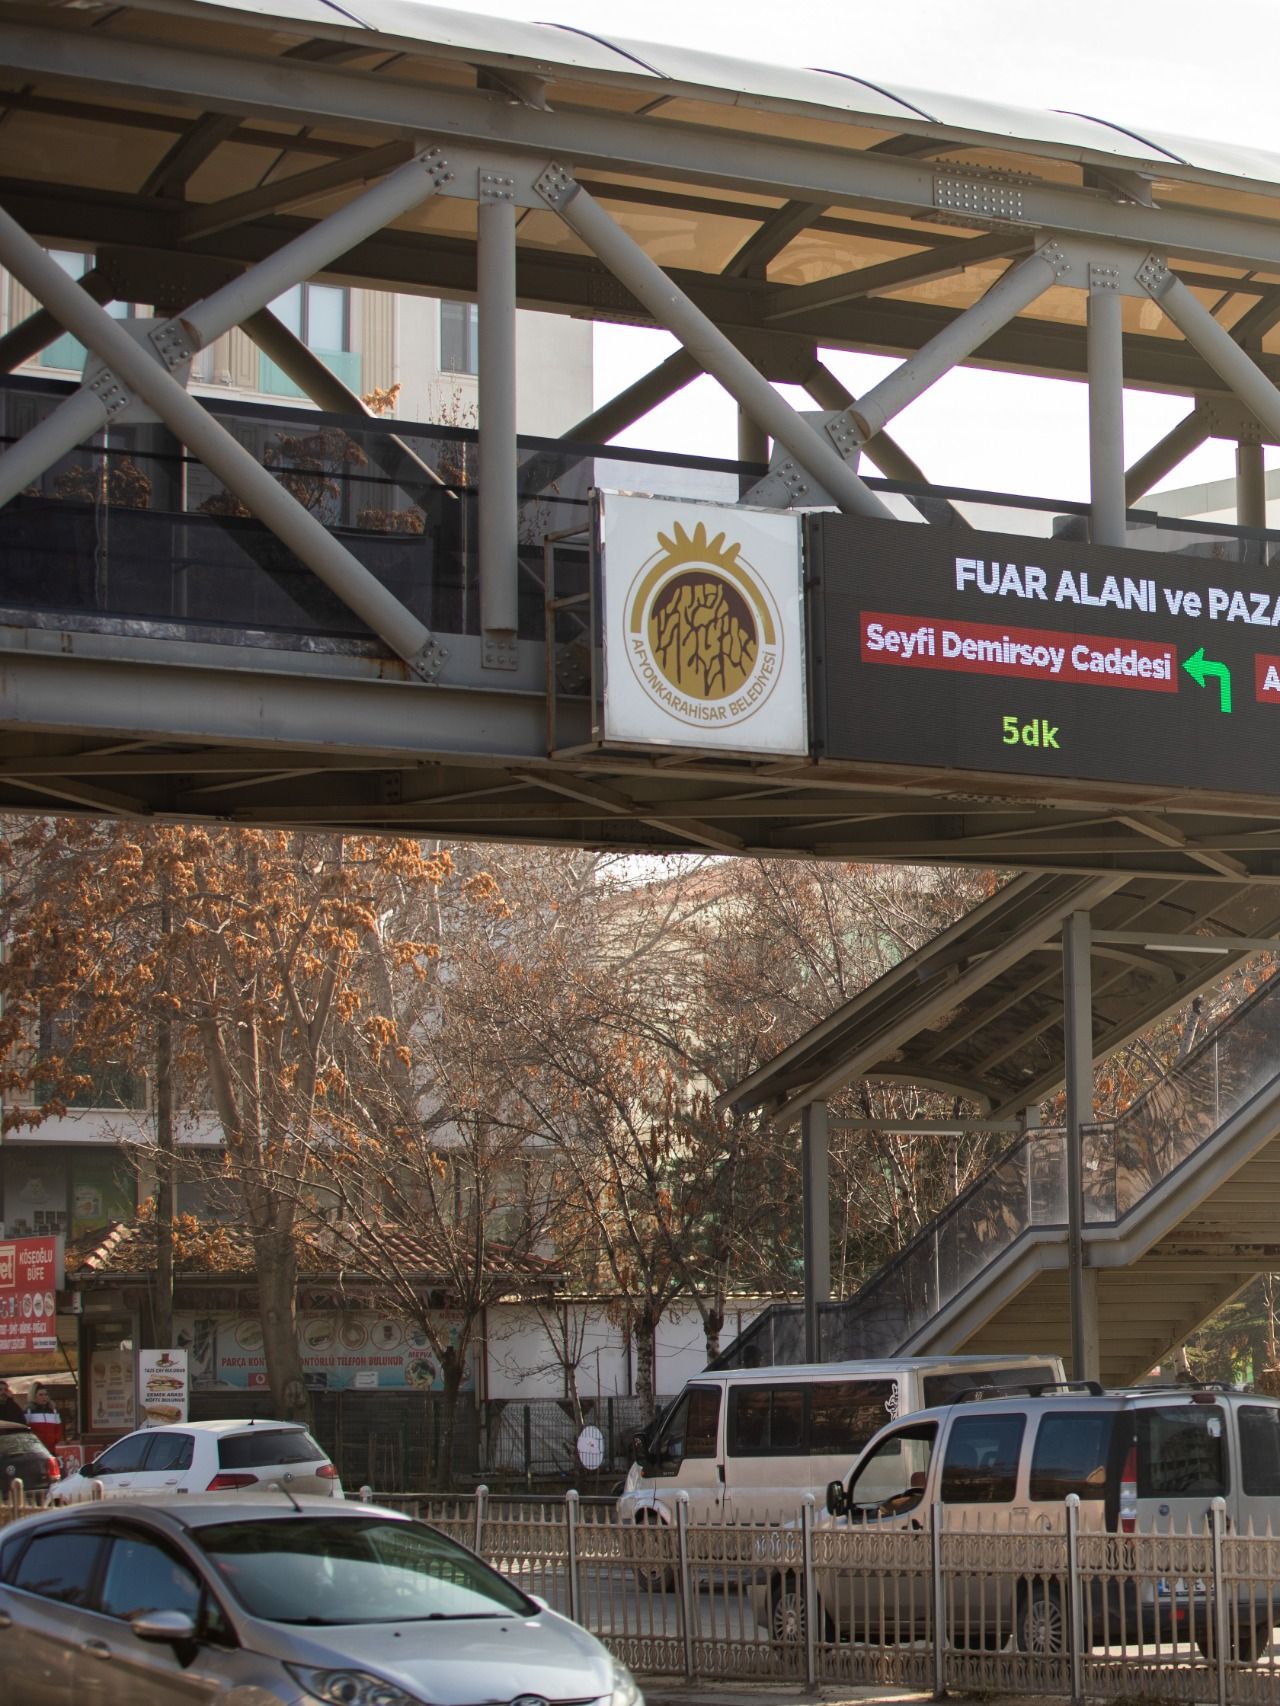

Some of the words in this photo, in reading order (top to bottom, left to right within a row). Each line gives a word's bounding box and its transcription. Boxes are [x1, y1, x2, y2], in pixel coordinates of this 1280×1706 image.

[955, 557, 1049, 600] FUAR
[1054, 570, 1157, 613] ALANI
[1163, 588, 1202, 617] ve
[631, 639, 727, 721] AFYONKARAHİSAR
[728, 650, 777, 716] BELEDİYESİ
[866, 623, 935, 658] Seyfi
[942, 631, 1065, 673] Demirsoy
[1071, 644, 1172, 680] Caddesi
[1002, 716, 1061, 749] 5dk
[27, 1265, 45, 1281] BÜFE
